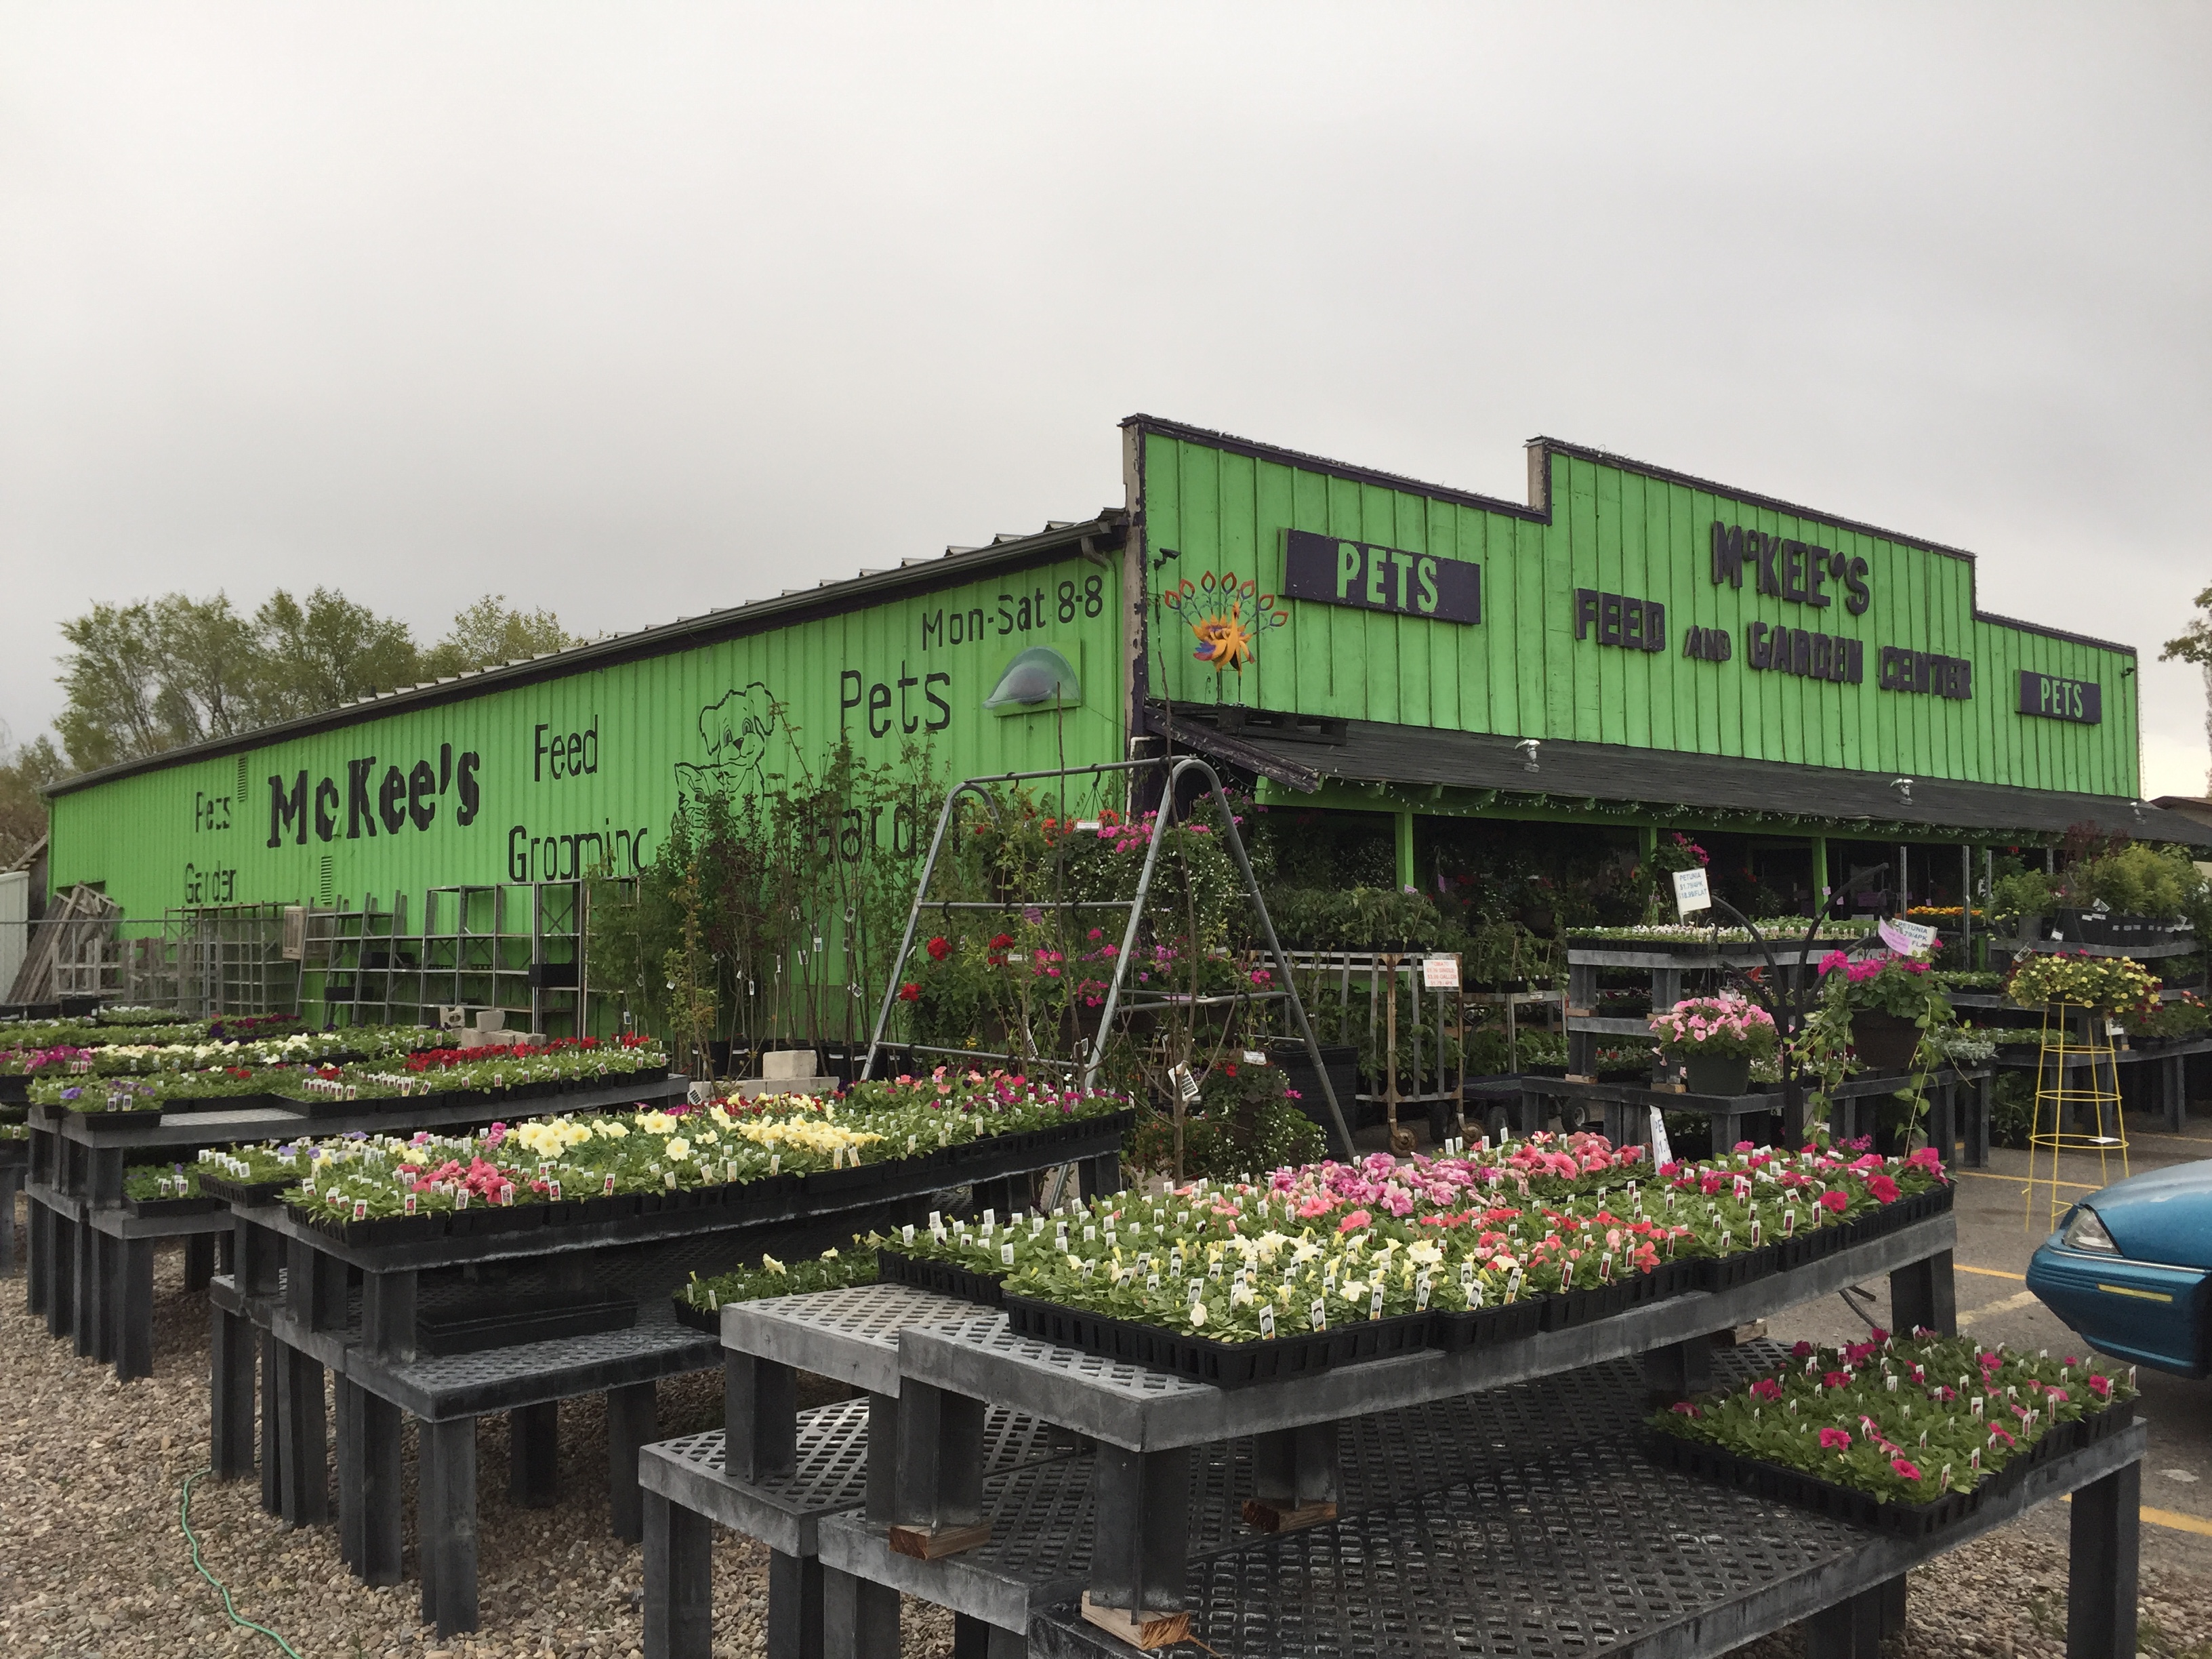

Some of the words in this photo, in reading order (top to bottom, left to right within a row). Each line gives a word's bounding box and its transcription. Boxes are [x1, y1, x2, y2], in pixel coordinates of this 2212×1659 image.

[922, 587, 1046, 651] Mon-Sat
[1057, 575, 1103, 623] 8-8
[1336, 541, 1438, 613] PETS
[1575, 588, 1666, 653] FEED
[1684, 625, 1732, 661] AND
[1749, 621, 1864, 684] GARDEN
[1879, 645, 1973, 700] CENTER
[840, 660, 951, 743] Pets
[2040, 677, 2084, 719] PETS
[533, 715, 598, 782] Feed
[267, 743, 480, 848] McKee's
[1679, 872, 1702, 881] PETUNIA
[1898, 922, 1927, 934] PETUNIA
